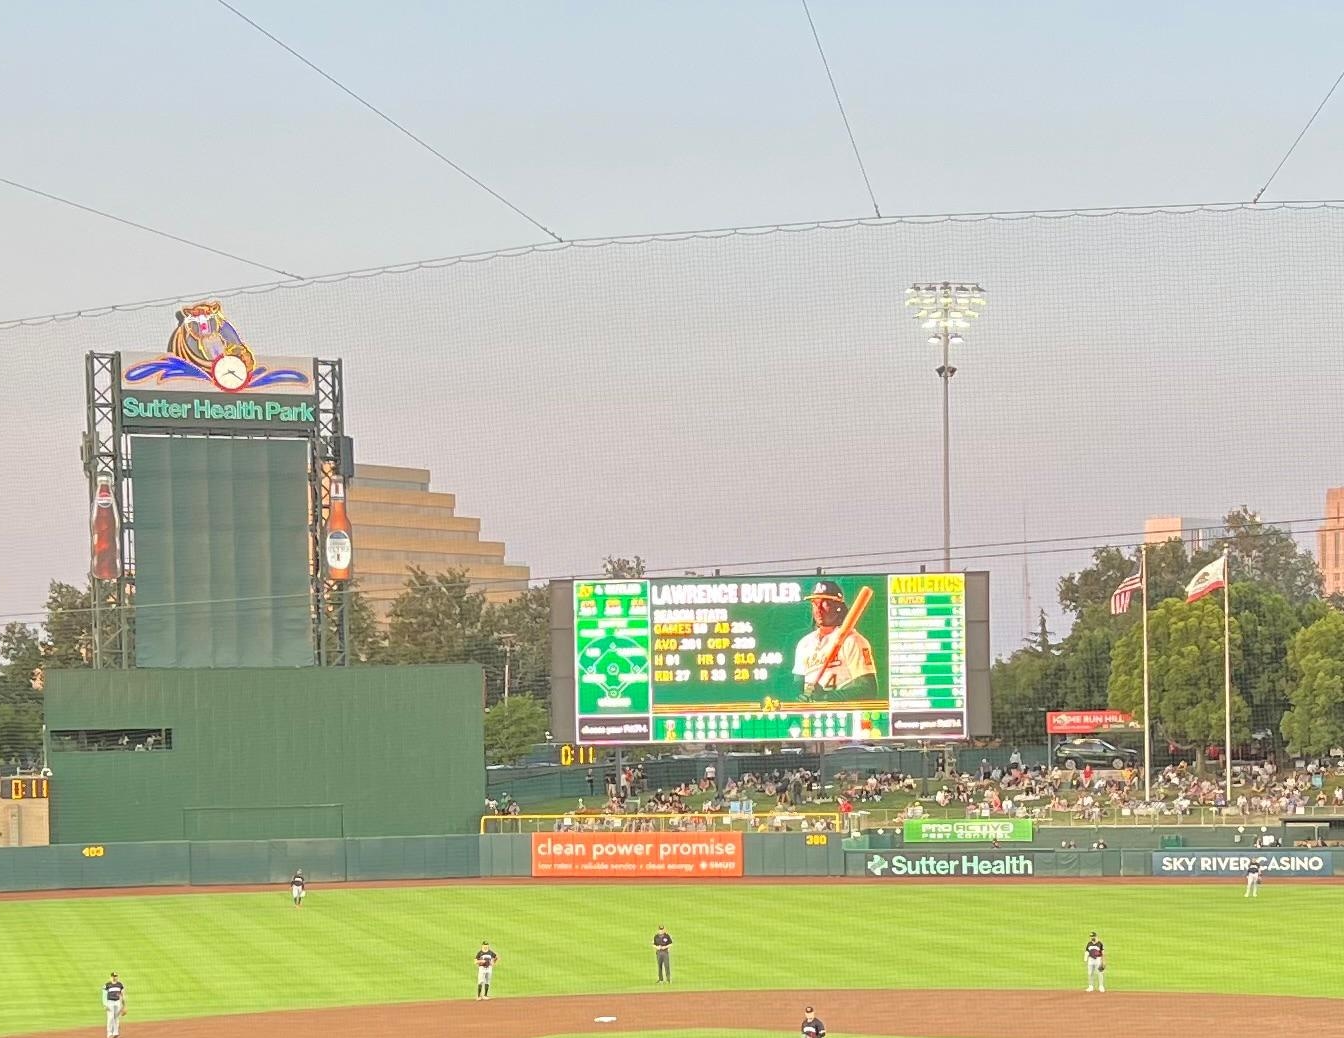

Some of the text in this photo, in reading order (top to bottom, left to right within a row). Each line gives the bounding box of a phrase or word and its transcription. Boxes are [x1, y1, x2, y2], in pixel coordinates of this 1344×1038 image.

[123, 396, 315, 422] Sutter Health Park
[652, 585, 738, 605] LAWRENCE
[740, 582, 801, 603] BUTLER
[892, 575, 962, 593] ATHLETICS
[654, 624, 692, 635] GAMES
[921, 823, 1011, 833] PRO ACTIVE
[537, 838, 736, 860] clean power promise
[891, 855, 1033, 876] Sutter Health
[1162, 856, 1324, 871] SKY RIVER CASINO
